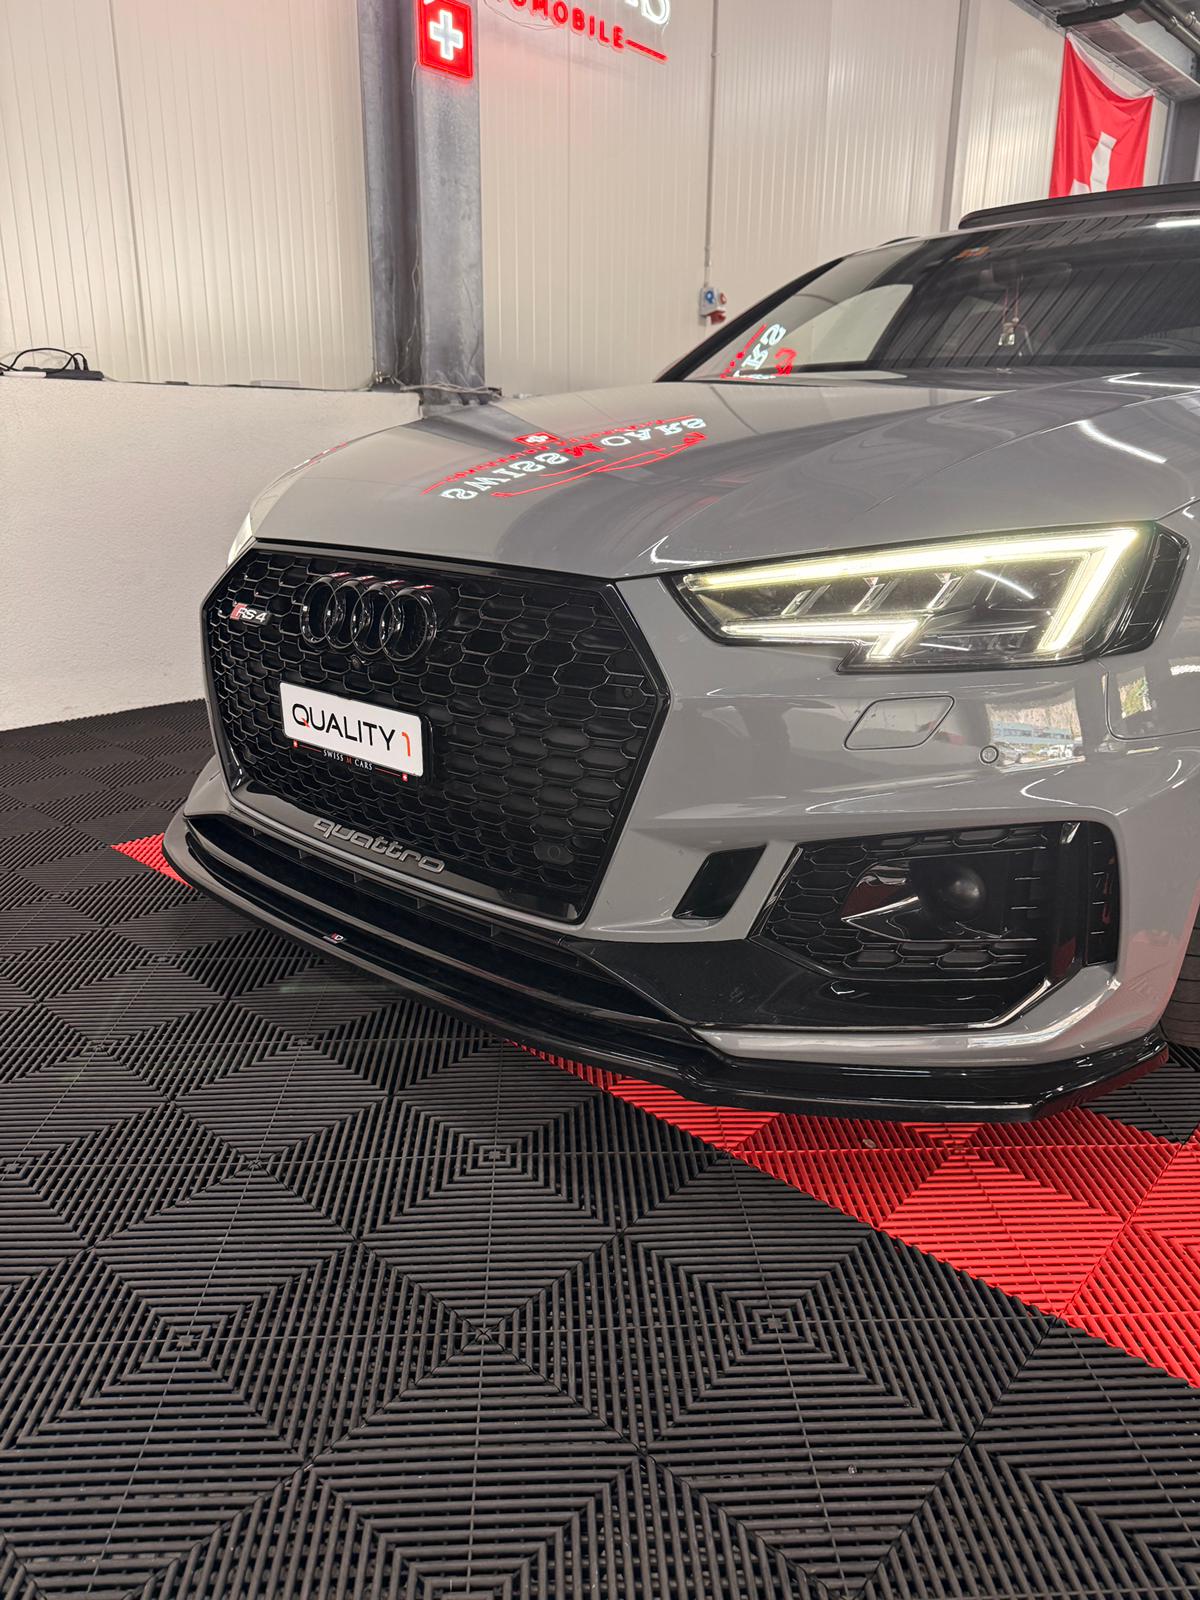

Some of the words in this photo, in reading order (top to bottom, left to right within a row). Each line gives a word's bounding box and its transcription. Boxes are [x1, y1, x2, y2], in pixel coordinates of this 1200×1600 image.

[498, 0, 624, 49] MOBILE
[323, 750, 344, 762] SWISS
[354, 759, 373, 771] CARS
[313, 818, 446, 874] quattro
